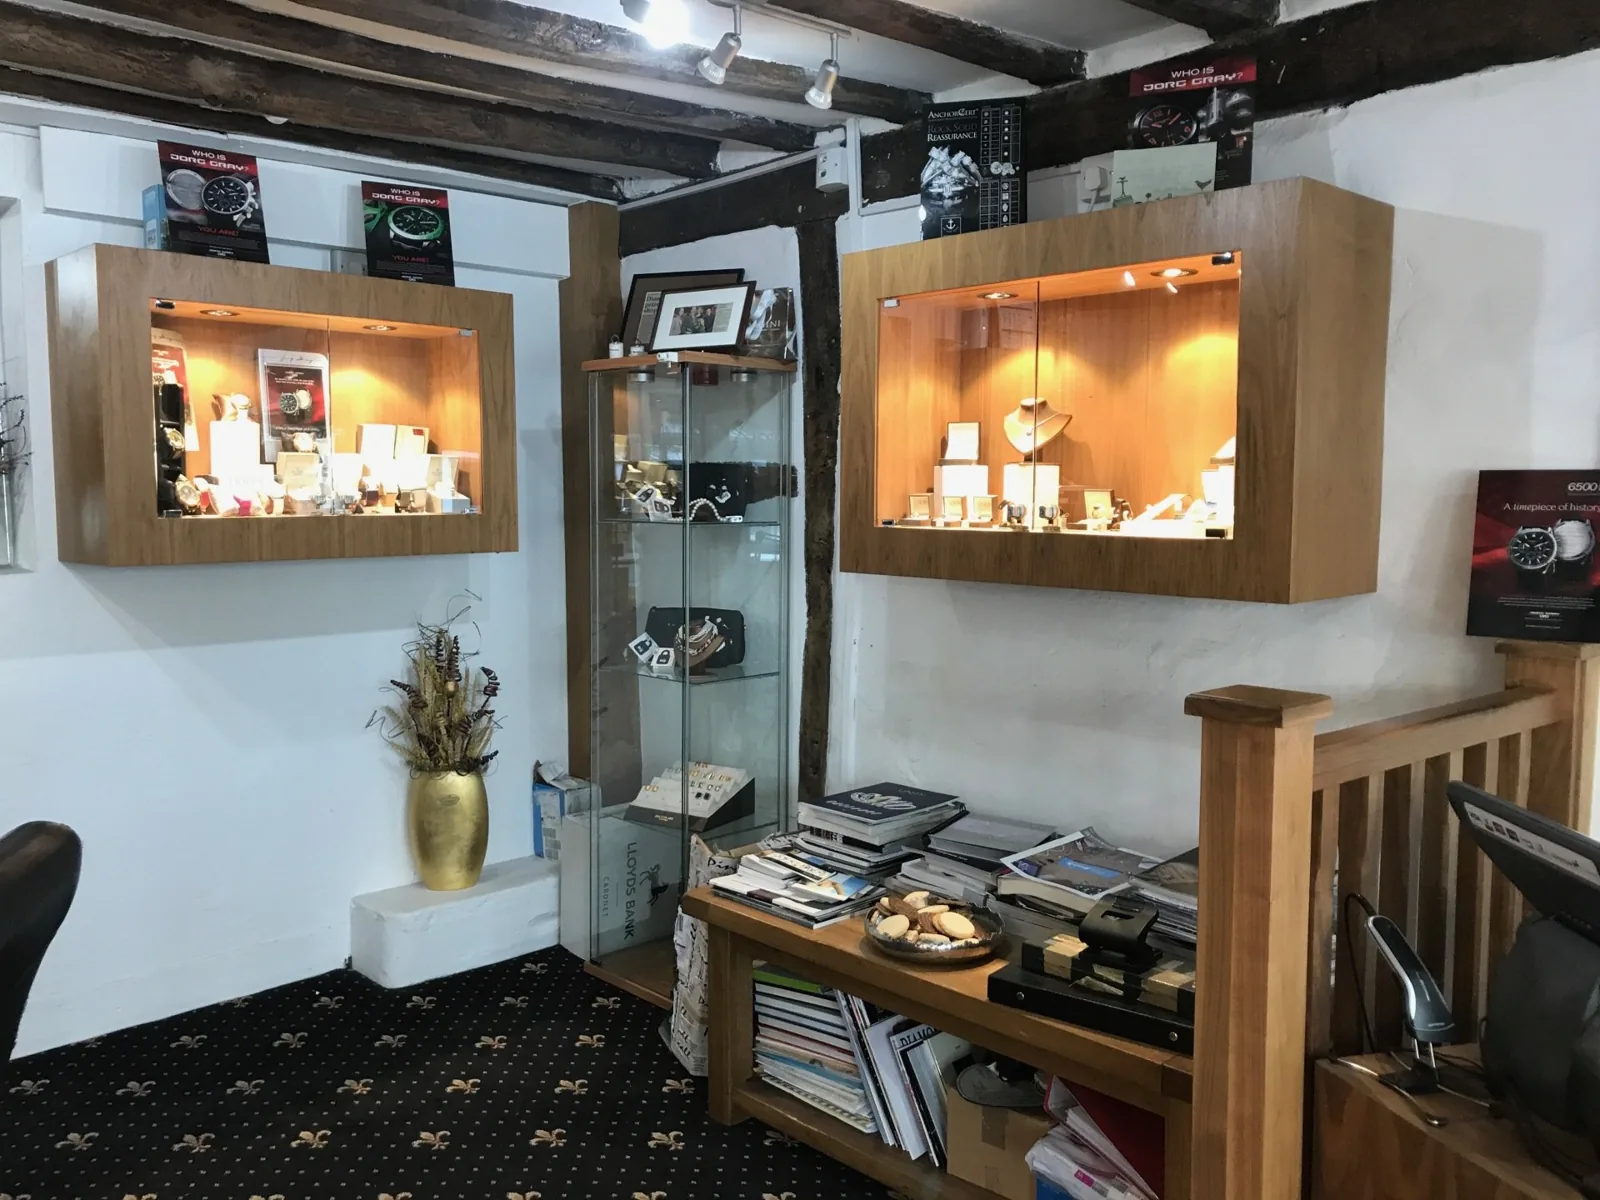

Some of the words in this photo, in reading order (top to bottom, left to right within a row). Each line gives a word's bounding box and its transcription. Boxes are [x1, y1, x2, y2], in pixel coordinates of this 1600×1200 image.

[1171, 67, 1200, 78] WHO
[1202, 66, 1214, 74] IS
[1143, 80, 1187, 91] JORG
[1191, 72, 1243, 86] GRAY?
[191, 149, 215, 159] WHO
[170, 153, 206, 165] JORG
[209, 160, 249, 171] GRAY?
[372, 192, 402, 201] JORG
[405, 196, 440, 205] GRAY?
[1567, 482, 1597, 492] 6500
[1503, 502, 1511, 511] A
[1513, 502, 1556, 513] timepiece
[1558, 502, 1569, 512] of
[625, 841, 637, 897] LLOYDS
[624, 902, 636, 940] BANK
